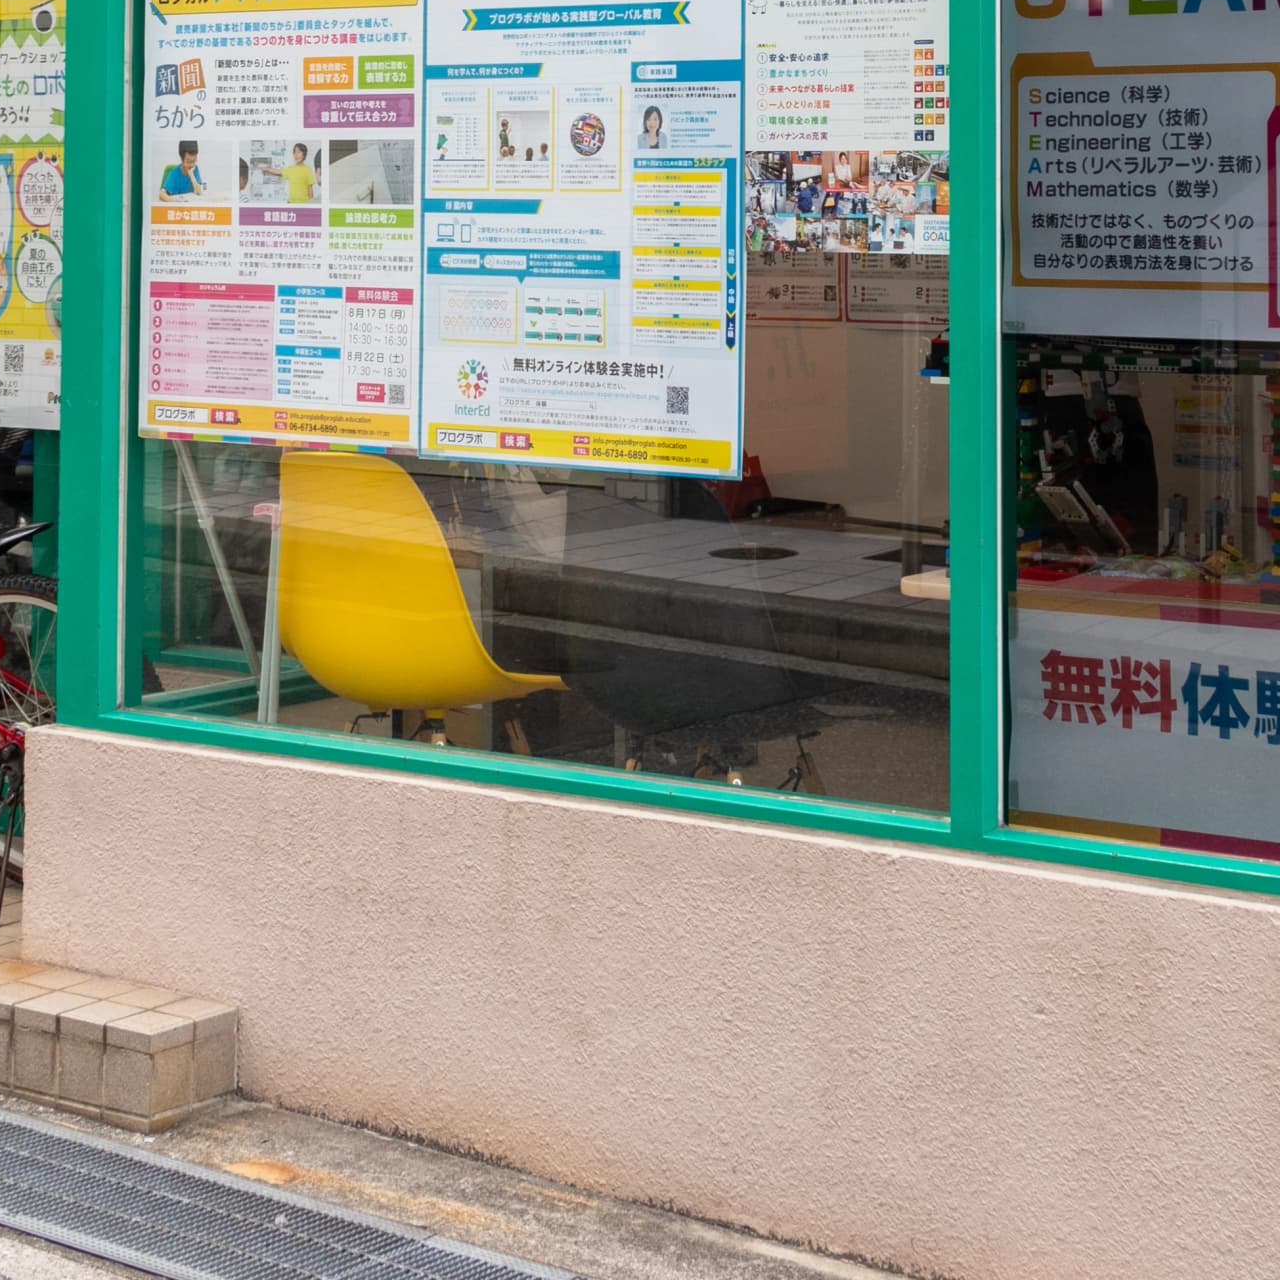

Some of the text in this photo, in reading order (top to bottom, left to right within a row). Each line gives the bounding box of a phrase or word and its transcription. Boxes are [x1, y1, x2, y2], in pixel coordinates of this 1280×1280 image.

[155, 104, 205, 129] ちから
[769, 132, 828, 140] ガバナンスの充実
[23, 183, 57, 193] ロボットは
[1060, 233, 1224, 252] 活動の中で創造性を養い
[29, 248, 46, 261] 夏の
[22, 262, 55, 273] 自由工作
[1033, 252, 1255, 273] 自分なりの表現方法を身につける
[357, 290, 399, 302] 無料体験会
[157, 408, 195, 421] プログラボ
[454, 403, 490, 418] InterEd
[289, 422, 338, 434] 06-6734-6890
[439, 430, 483, 445] プログラボ
[592, 447, 648, 460] 06-6734-6890
